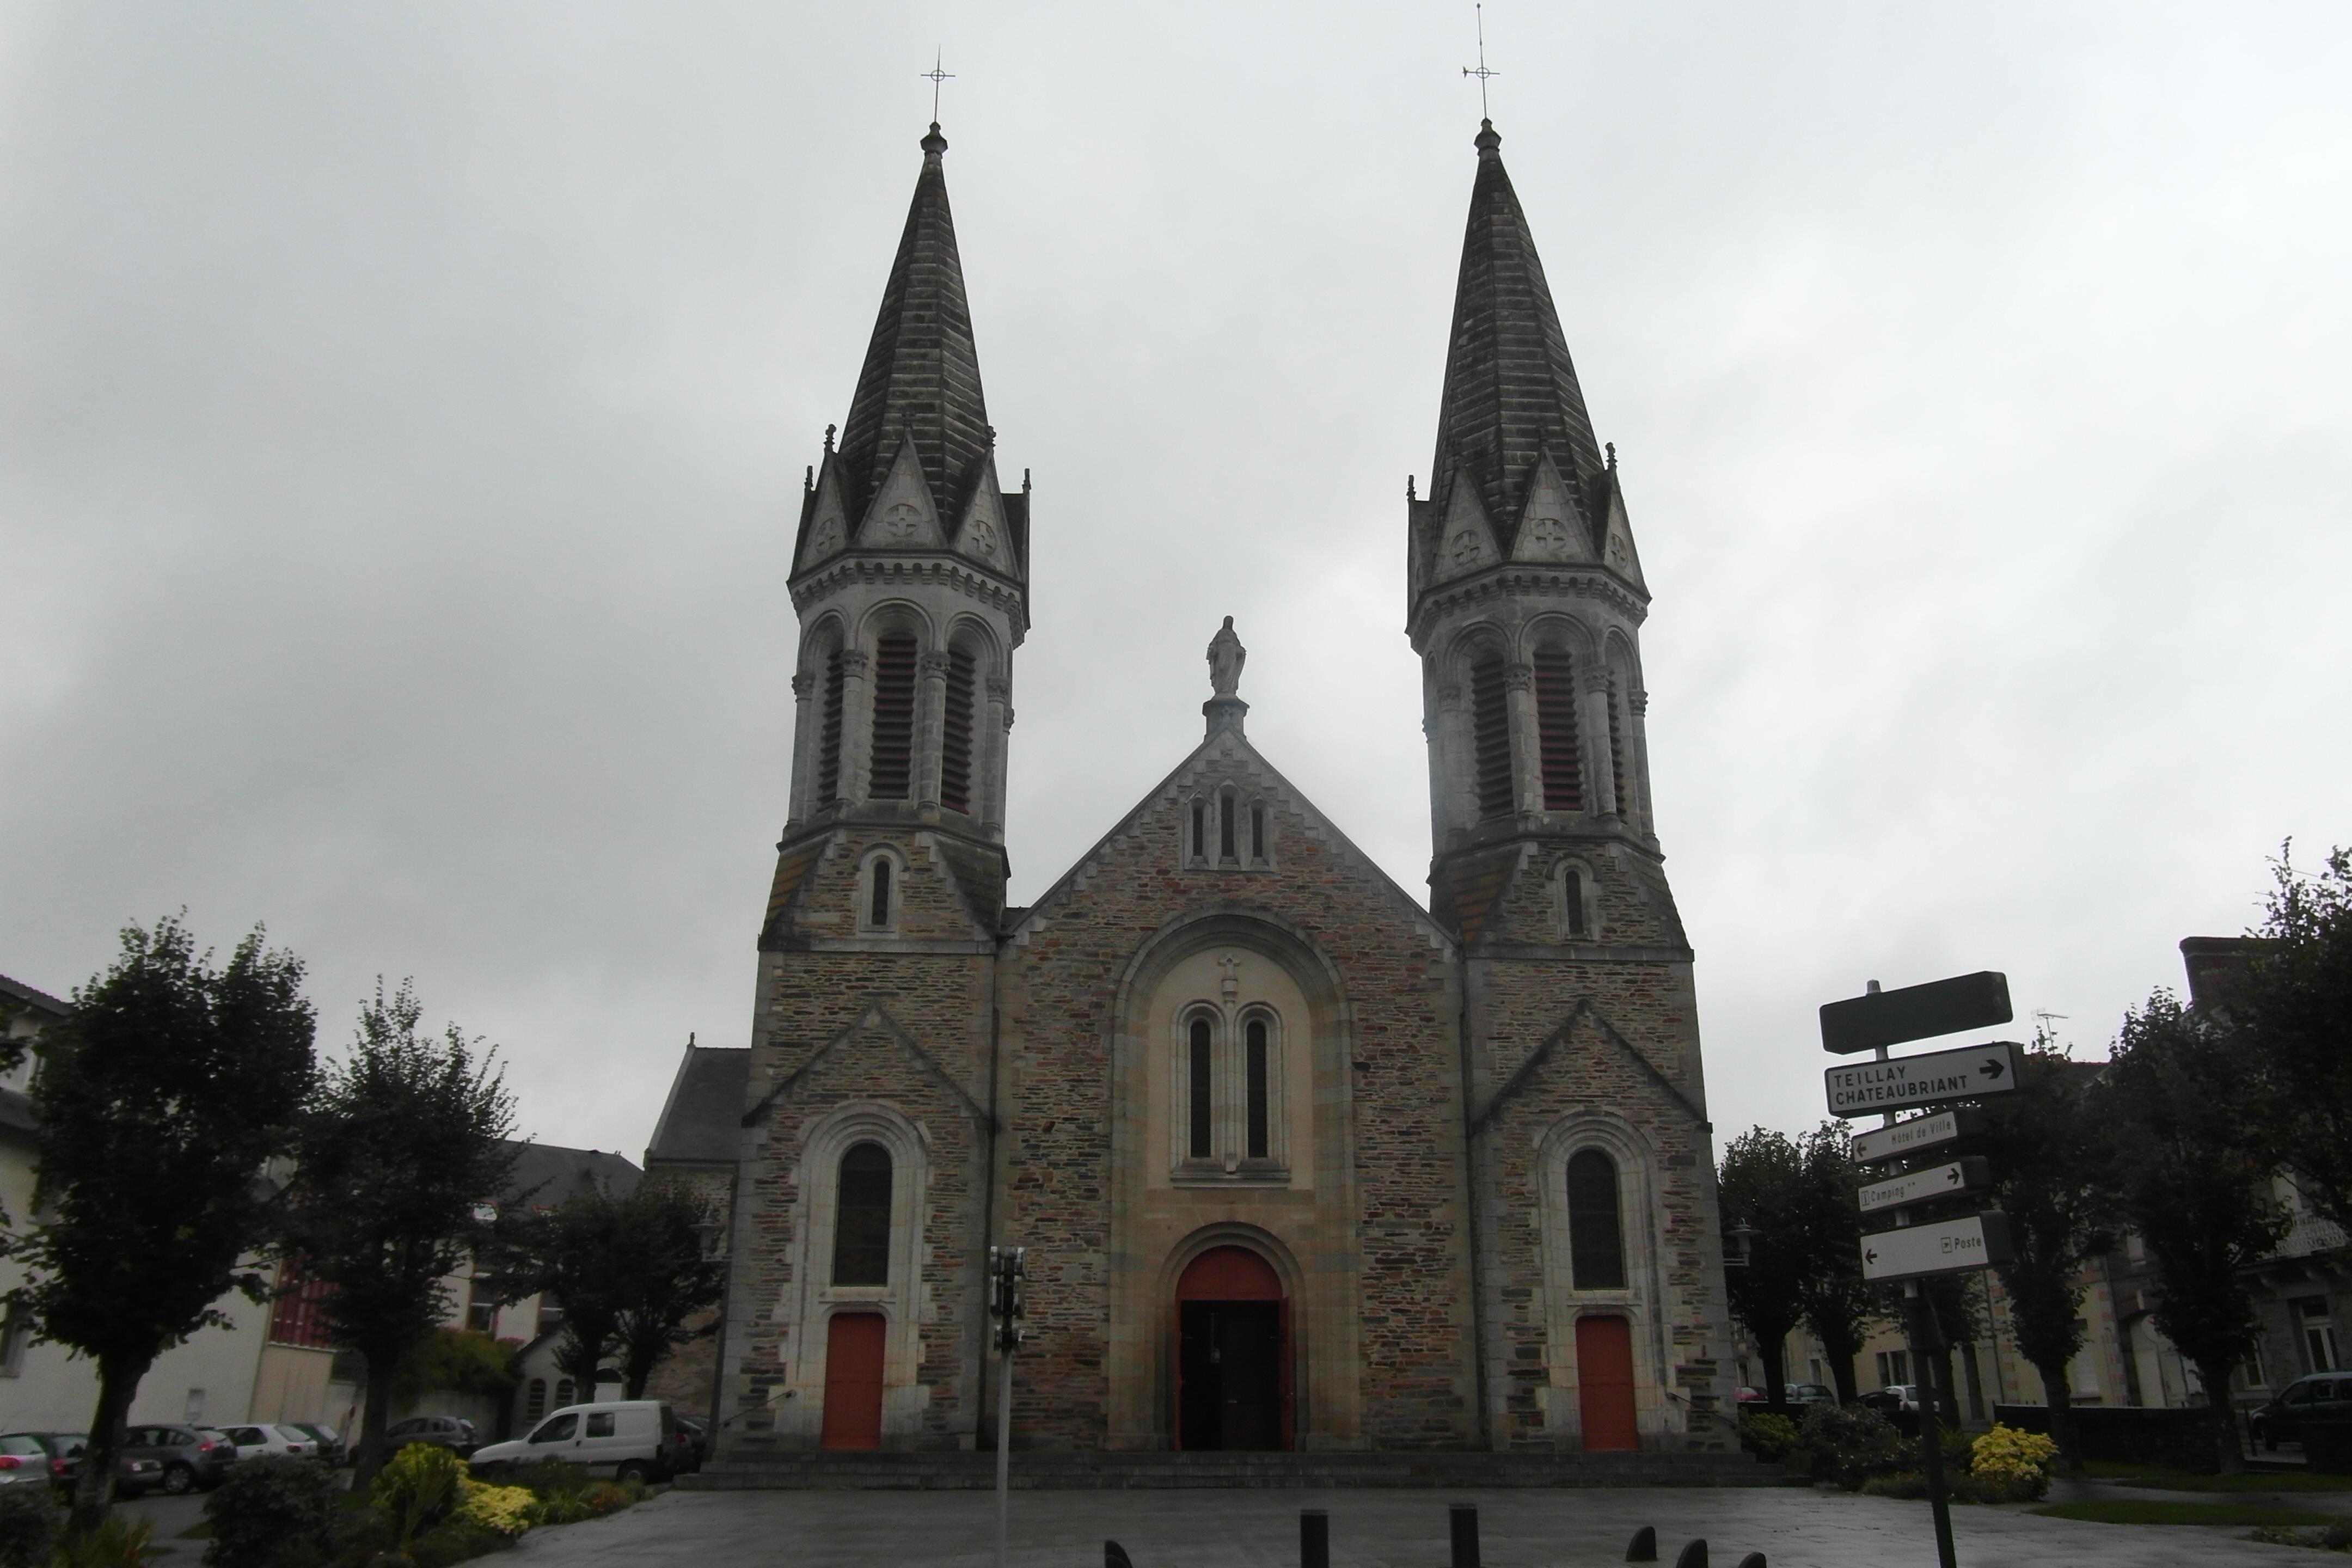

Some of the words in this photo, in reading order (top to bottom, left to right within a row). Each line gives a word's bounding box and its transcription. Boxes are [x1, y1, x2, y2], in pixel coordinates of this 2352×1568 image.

[1834, 1065, 1906, 1088] TEILLAY
[1836, 1075, 1967, 1105] CHATEAUBRIANT
[1917, 1126, 1926, 1138] de
[1930, 1119, 1951, 1134] Ville
[1871, 1187, 1904, 1202] Camping
[1955, 1237, 1981, 1249] Poste
